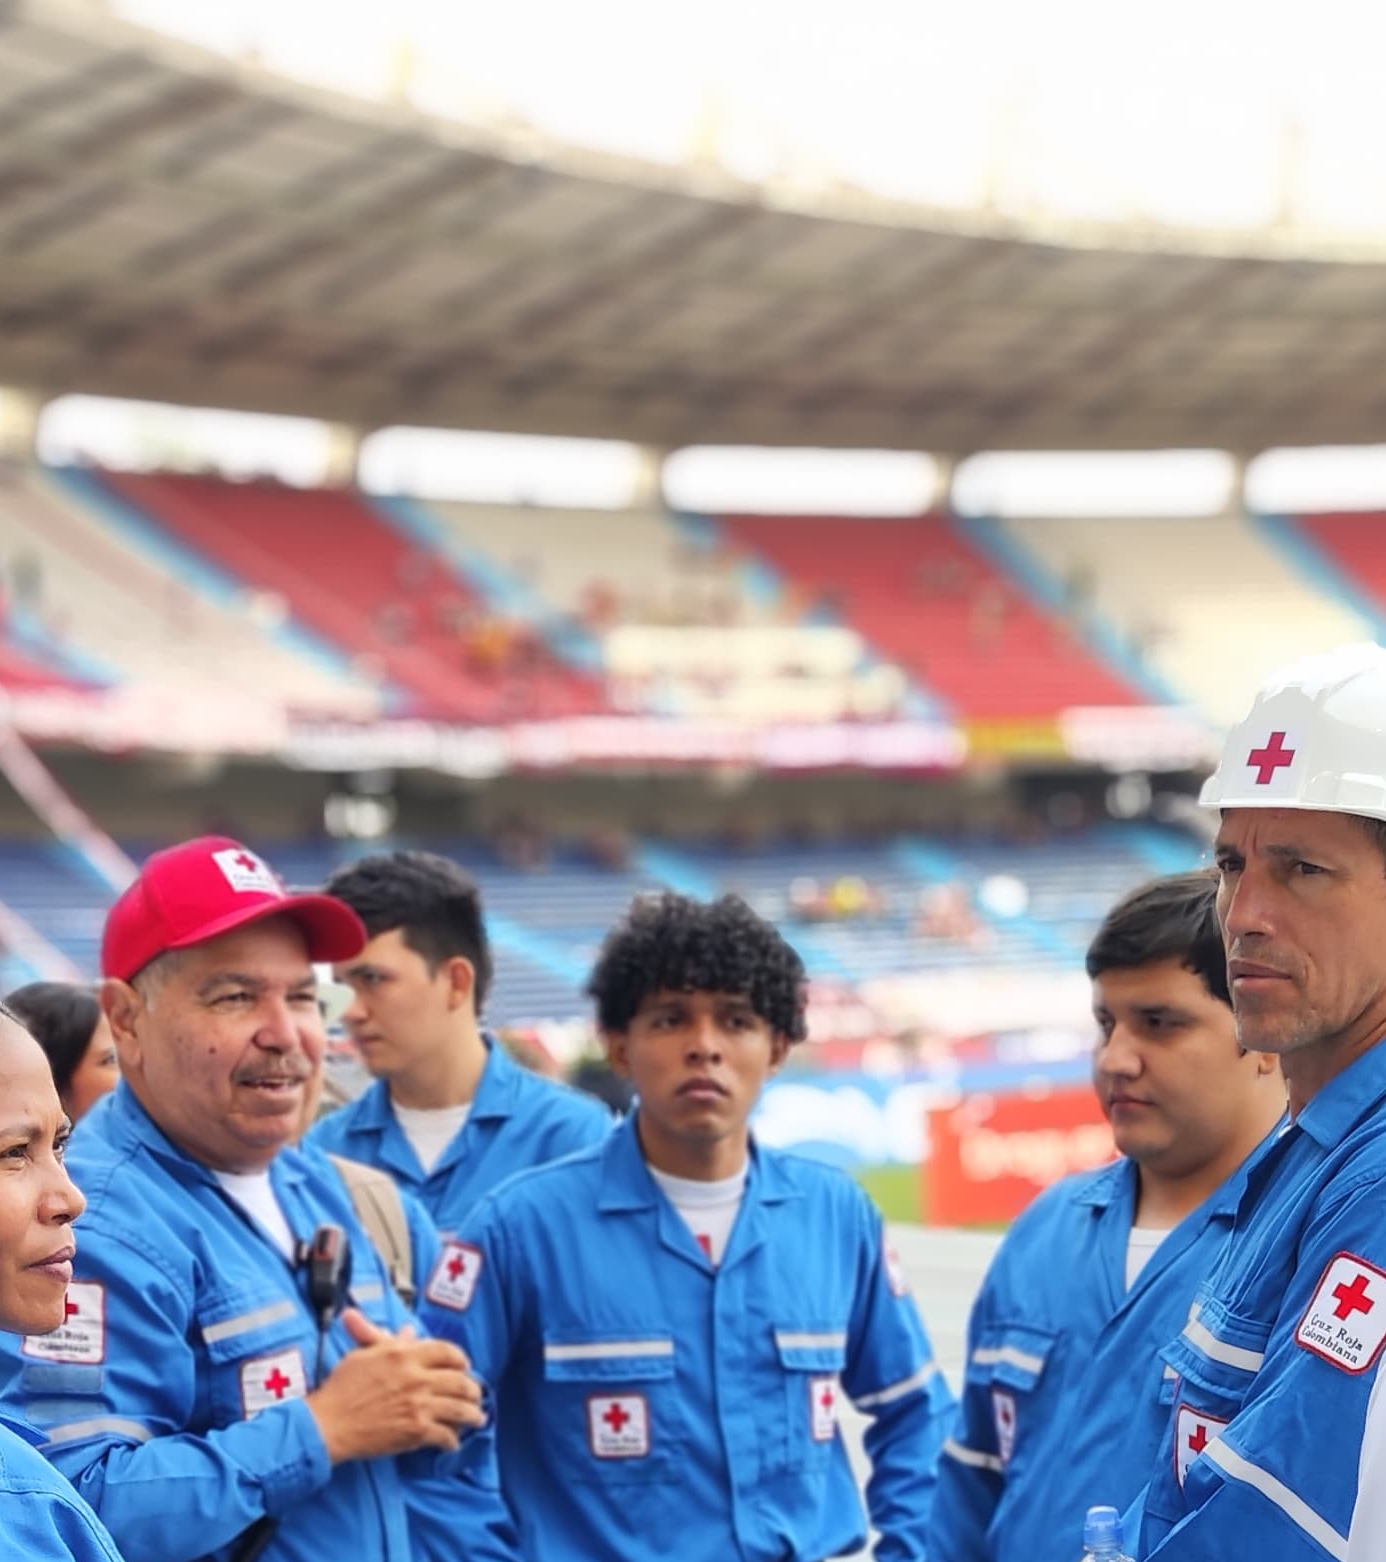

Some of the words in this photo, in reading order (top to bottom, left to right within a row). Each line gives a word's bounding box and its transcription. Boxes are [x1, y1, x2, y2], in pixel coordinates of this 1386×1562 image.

[1301, 1324, 1359, 1365] Colombiana
[1310, 1313, 1333, 1333] Cruz
[1336, 1326, 1364, 1352] Roja
